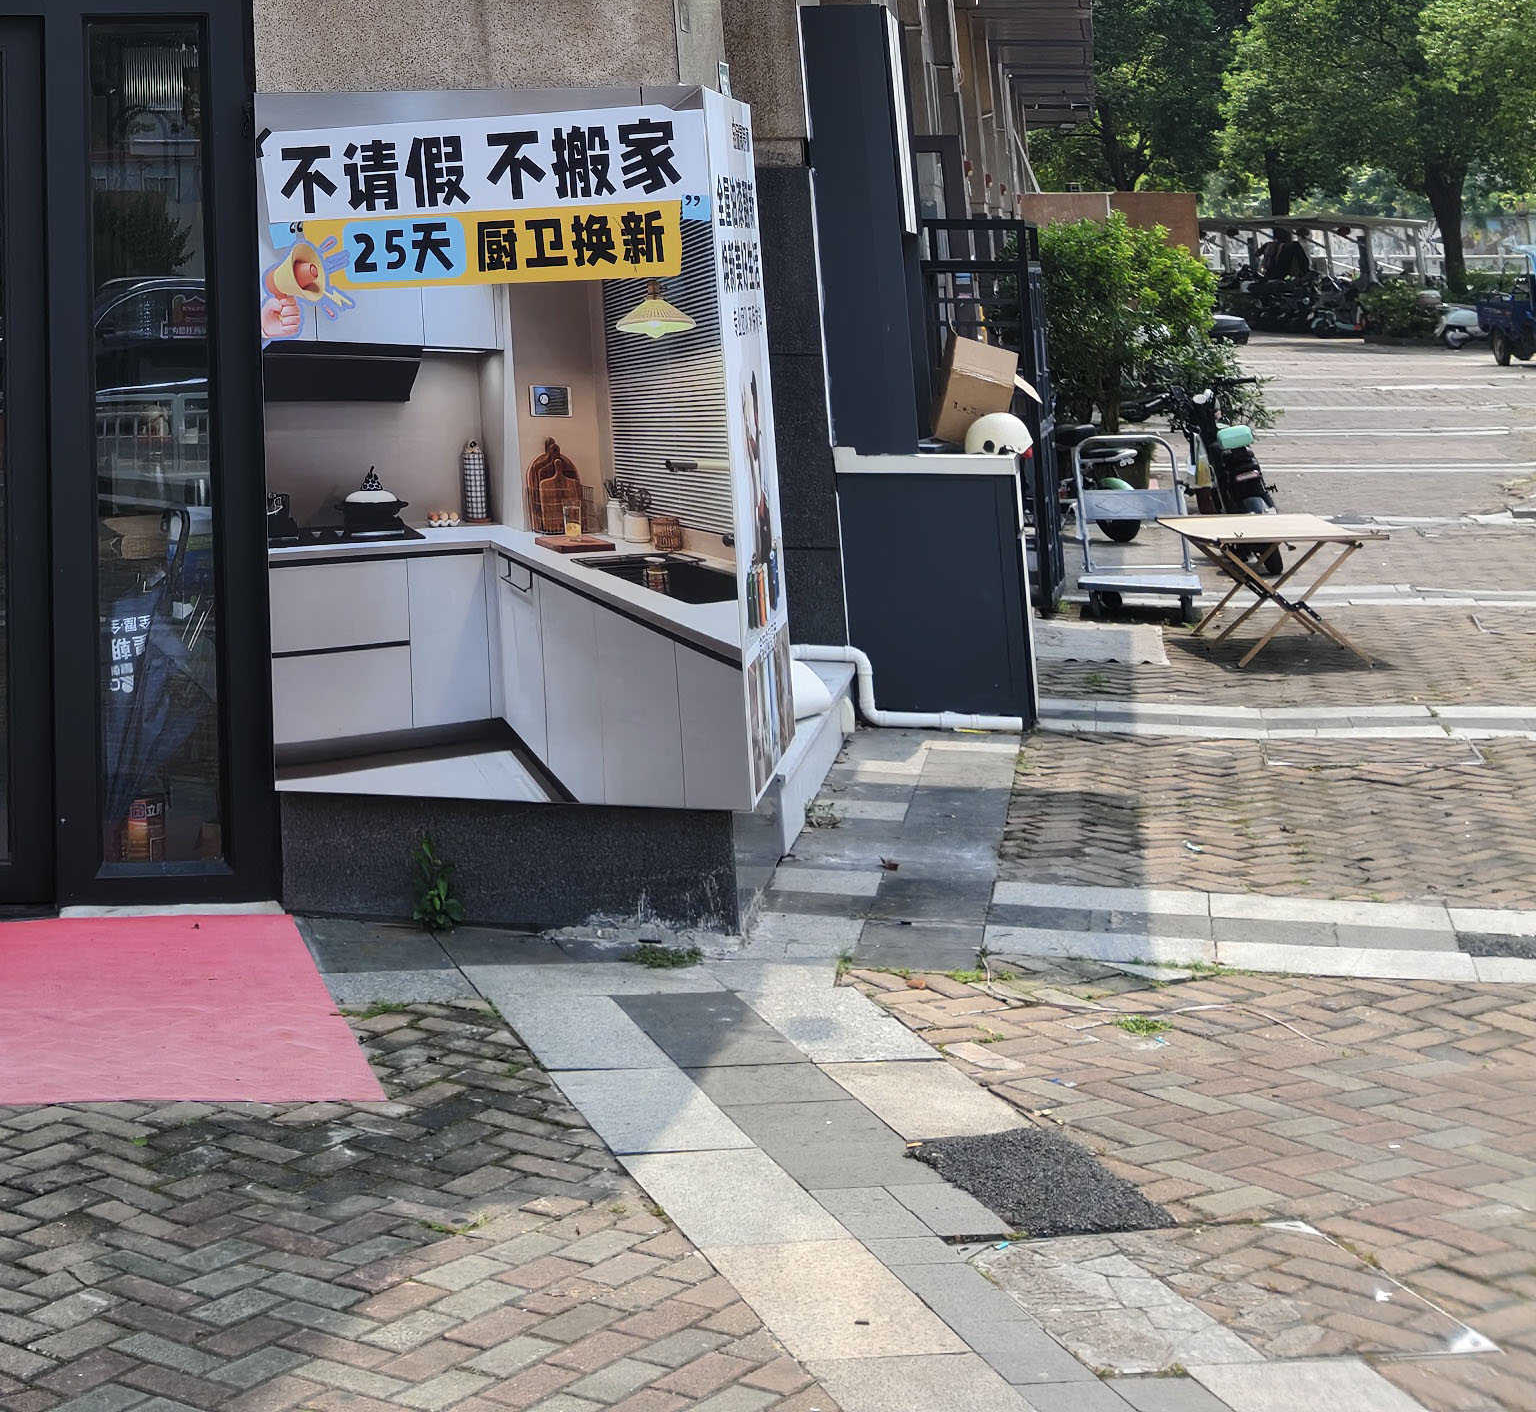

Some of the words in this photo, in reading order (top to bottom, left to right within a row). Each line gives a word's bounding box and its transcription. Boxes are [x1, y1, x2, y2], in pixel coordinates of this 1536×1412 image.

[280, 134, 472, 214] 不请假
[486, 118, 682, 201] 不搬家
[352, 221, 455, 274] 25天
[477, 209, 665, 272] 厨卫换新
